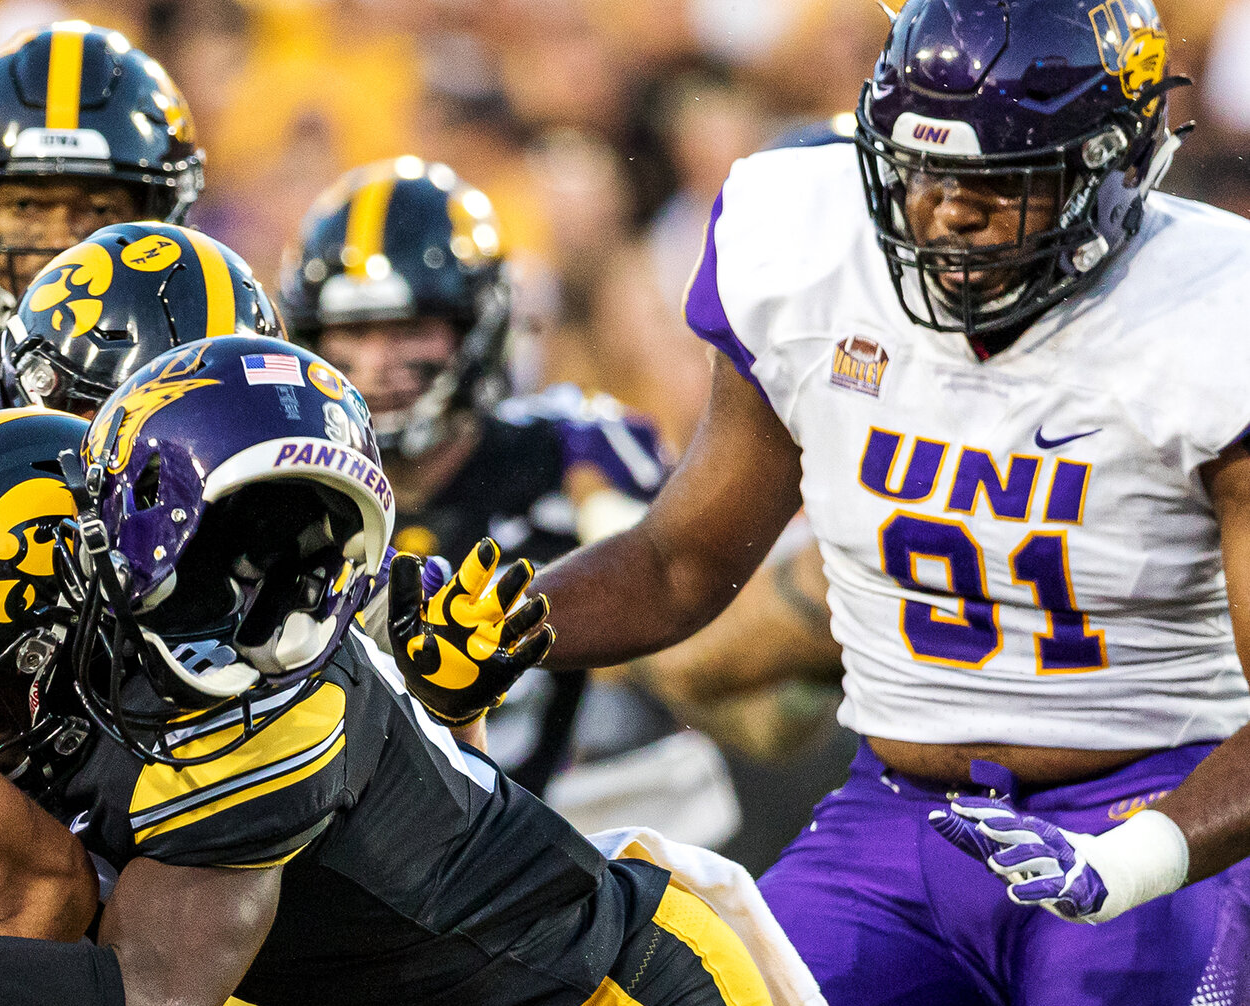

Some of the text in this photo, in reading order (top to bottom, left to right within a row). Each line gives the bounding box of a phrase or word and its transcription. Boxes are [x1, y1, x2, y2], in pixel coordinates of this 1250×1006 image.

[912, 123, 950, 145] UNI
[130, 241, 172, 264] ANF
[833, 346, 889, 387] VALLEY
[274, 443, 393, 512] PANTHERS
[857, 425, 1092, 526] UNI
[877, 508, 1109, 676] 91
